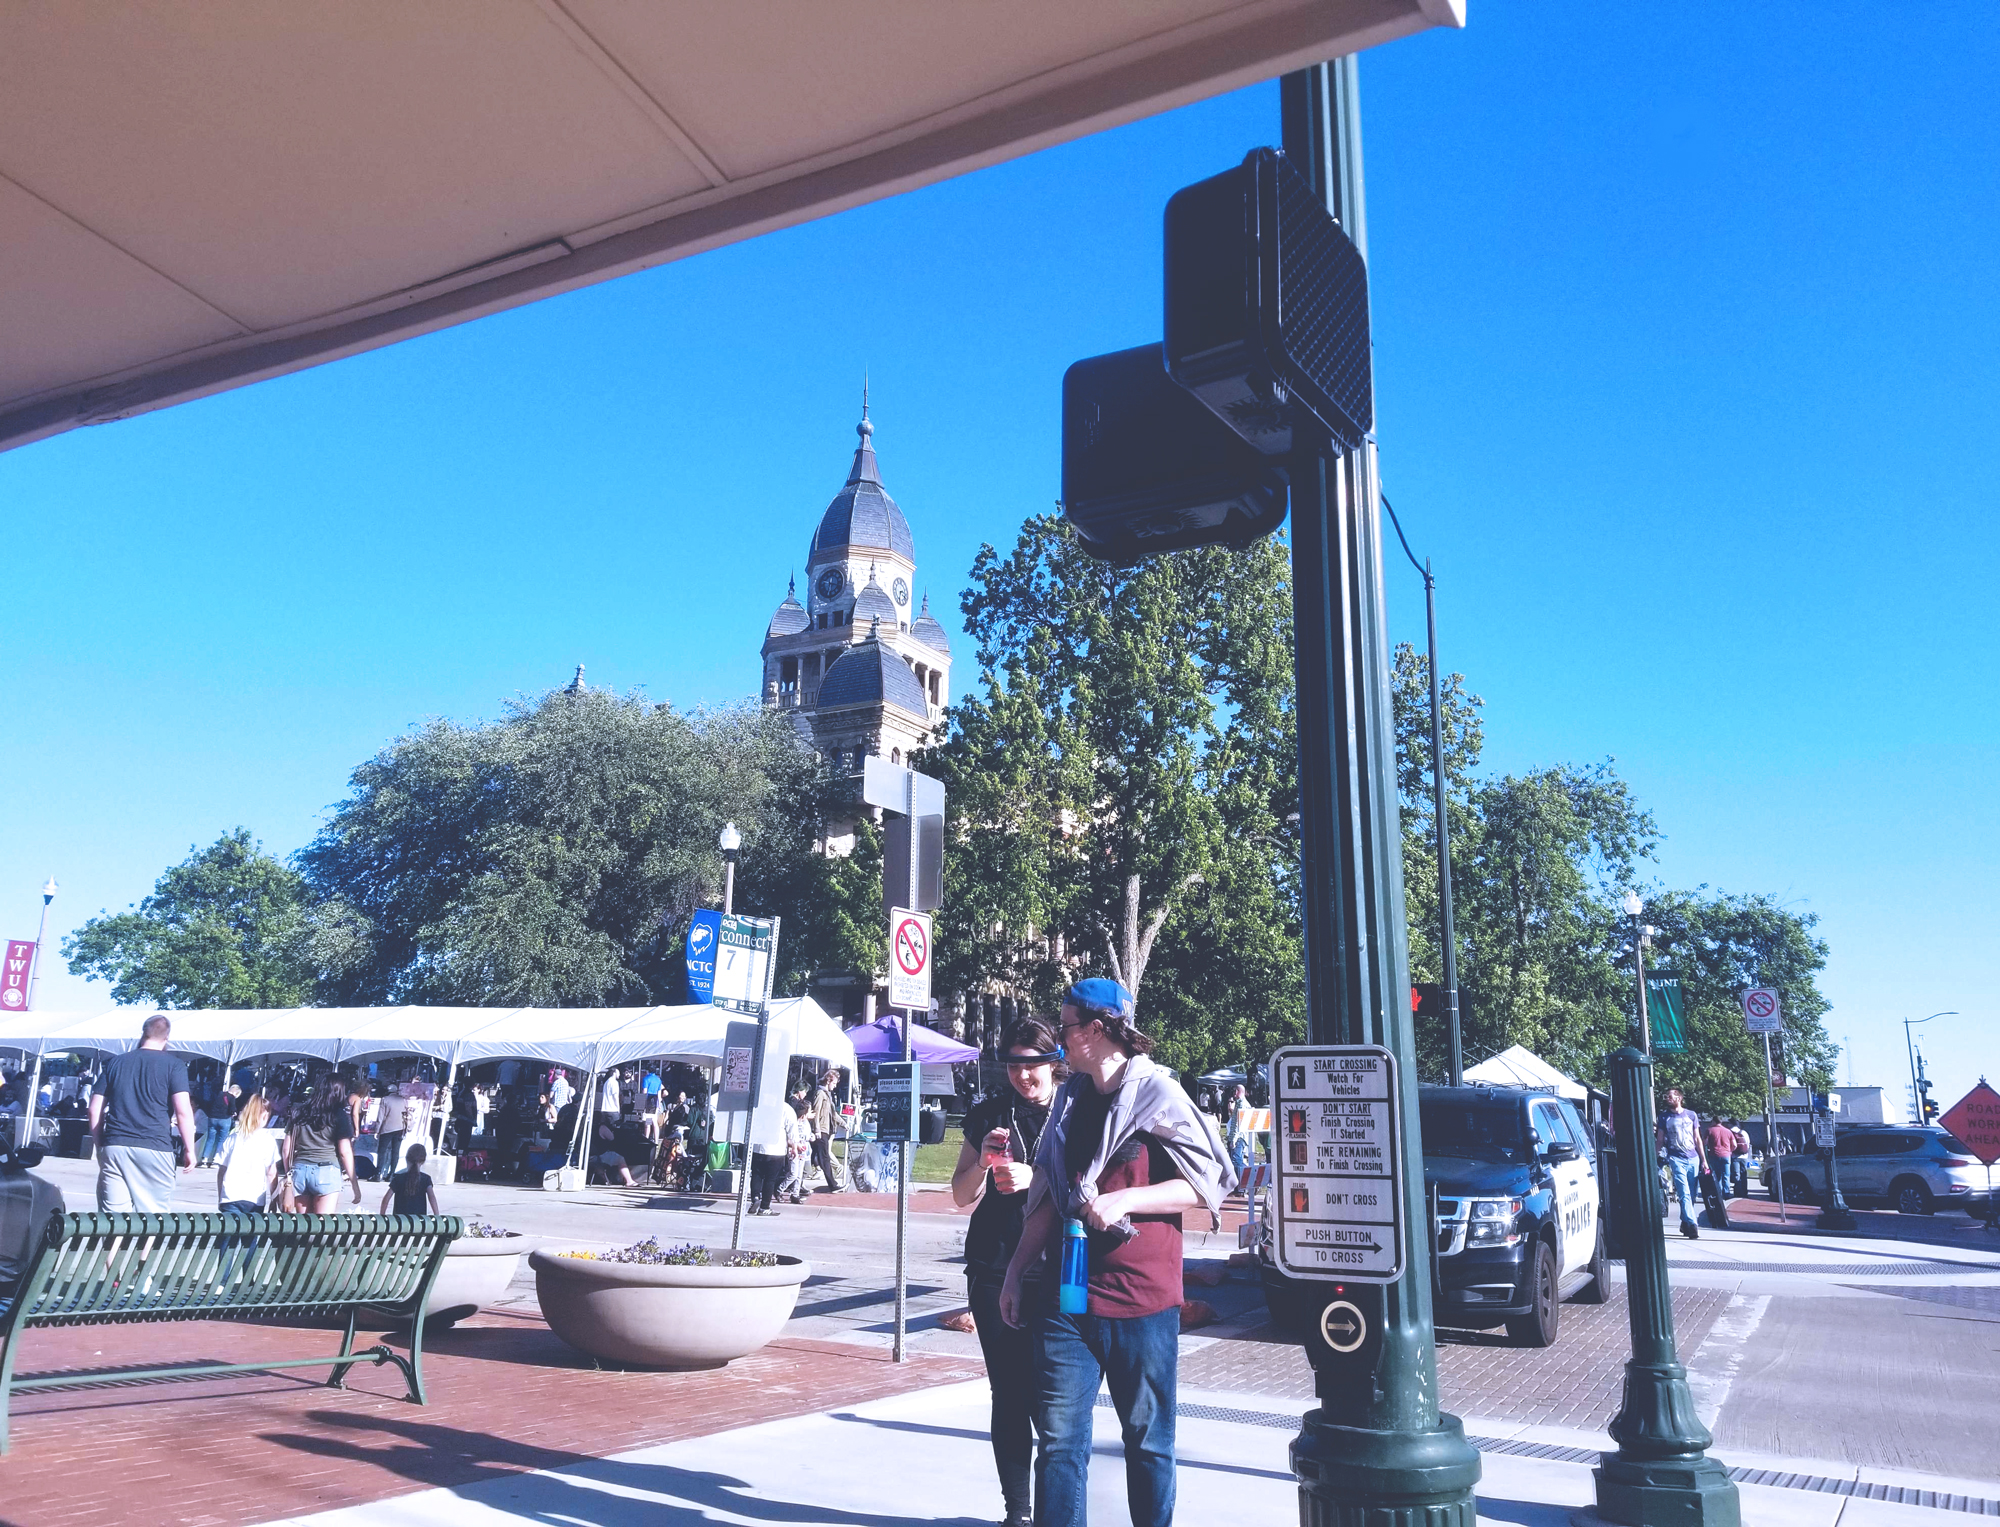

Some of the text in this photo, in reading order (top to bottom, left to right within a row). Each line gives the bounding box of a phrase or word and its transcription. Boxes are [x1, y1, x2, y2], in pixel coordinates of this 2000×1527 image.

[721, 930, 766, 950] connect
[8, 944, 28, 987] TWU
[686, 959, 713, 973] NCTC
[726, 949, 737, 971] 7
[697, 980, 710, 989] 1924
[1313, 1059, 1378, 1070] START CROSSING
[1327, 1073, 1364, 1083] Watch For
[1331, 1085, 1360, 1095] Vehicles
[1322, 1103, 1371, 1114] DON'T START
[1967, 1103, 2000, 1115] ROAD
[1320, 1117, 1375, 1130] Finish Crossing
[1330, 1129, 1366, 1140] If Started
[1965, 1133, 2000, 1145] AHEA
[1316, 1146, 1382, 1158] TIME REMAINING
[1316, 1158, 1383, 1173] To Finish Crossing
[1326, 1193, 1378, 1206] DON'T CROSS
[1565, 1201, 1591, 1240] POLICE
[1305, 1229, 1372, 1243] PUSH BUTTON
[1315, 1250, 1364, 1264] TO CROSS
